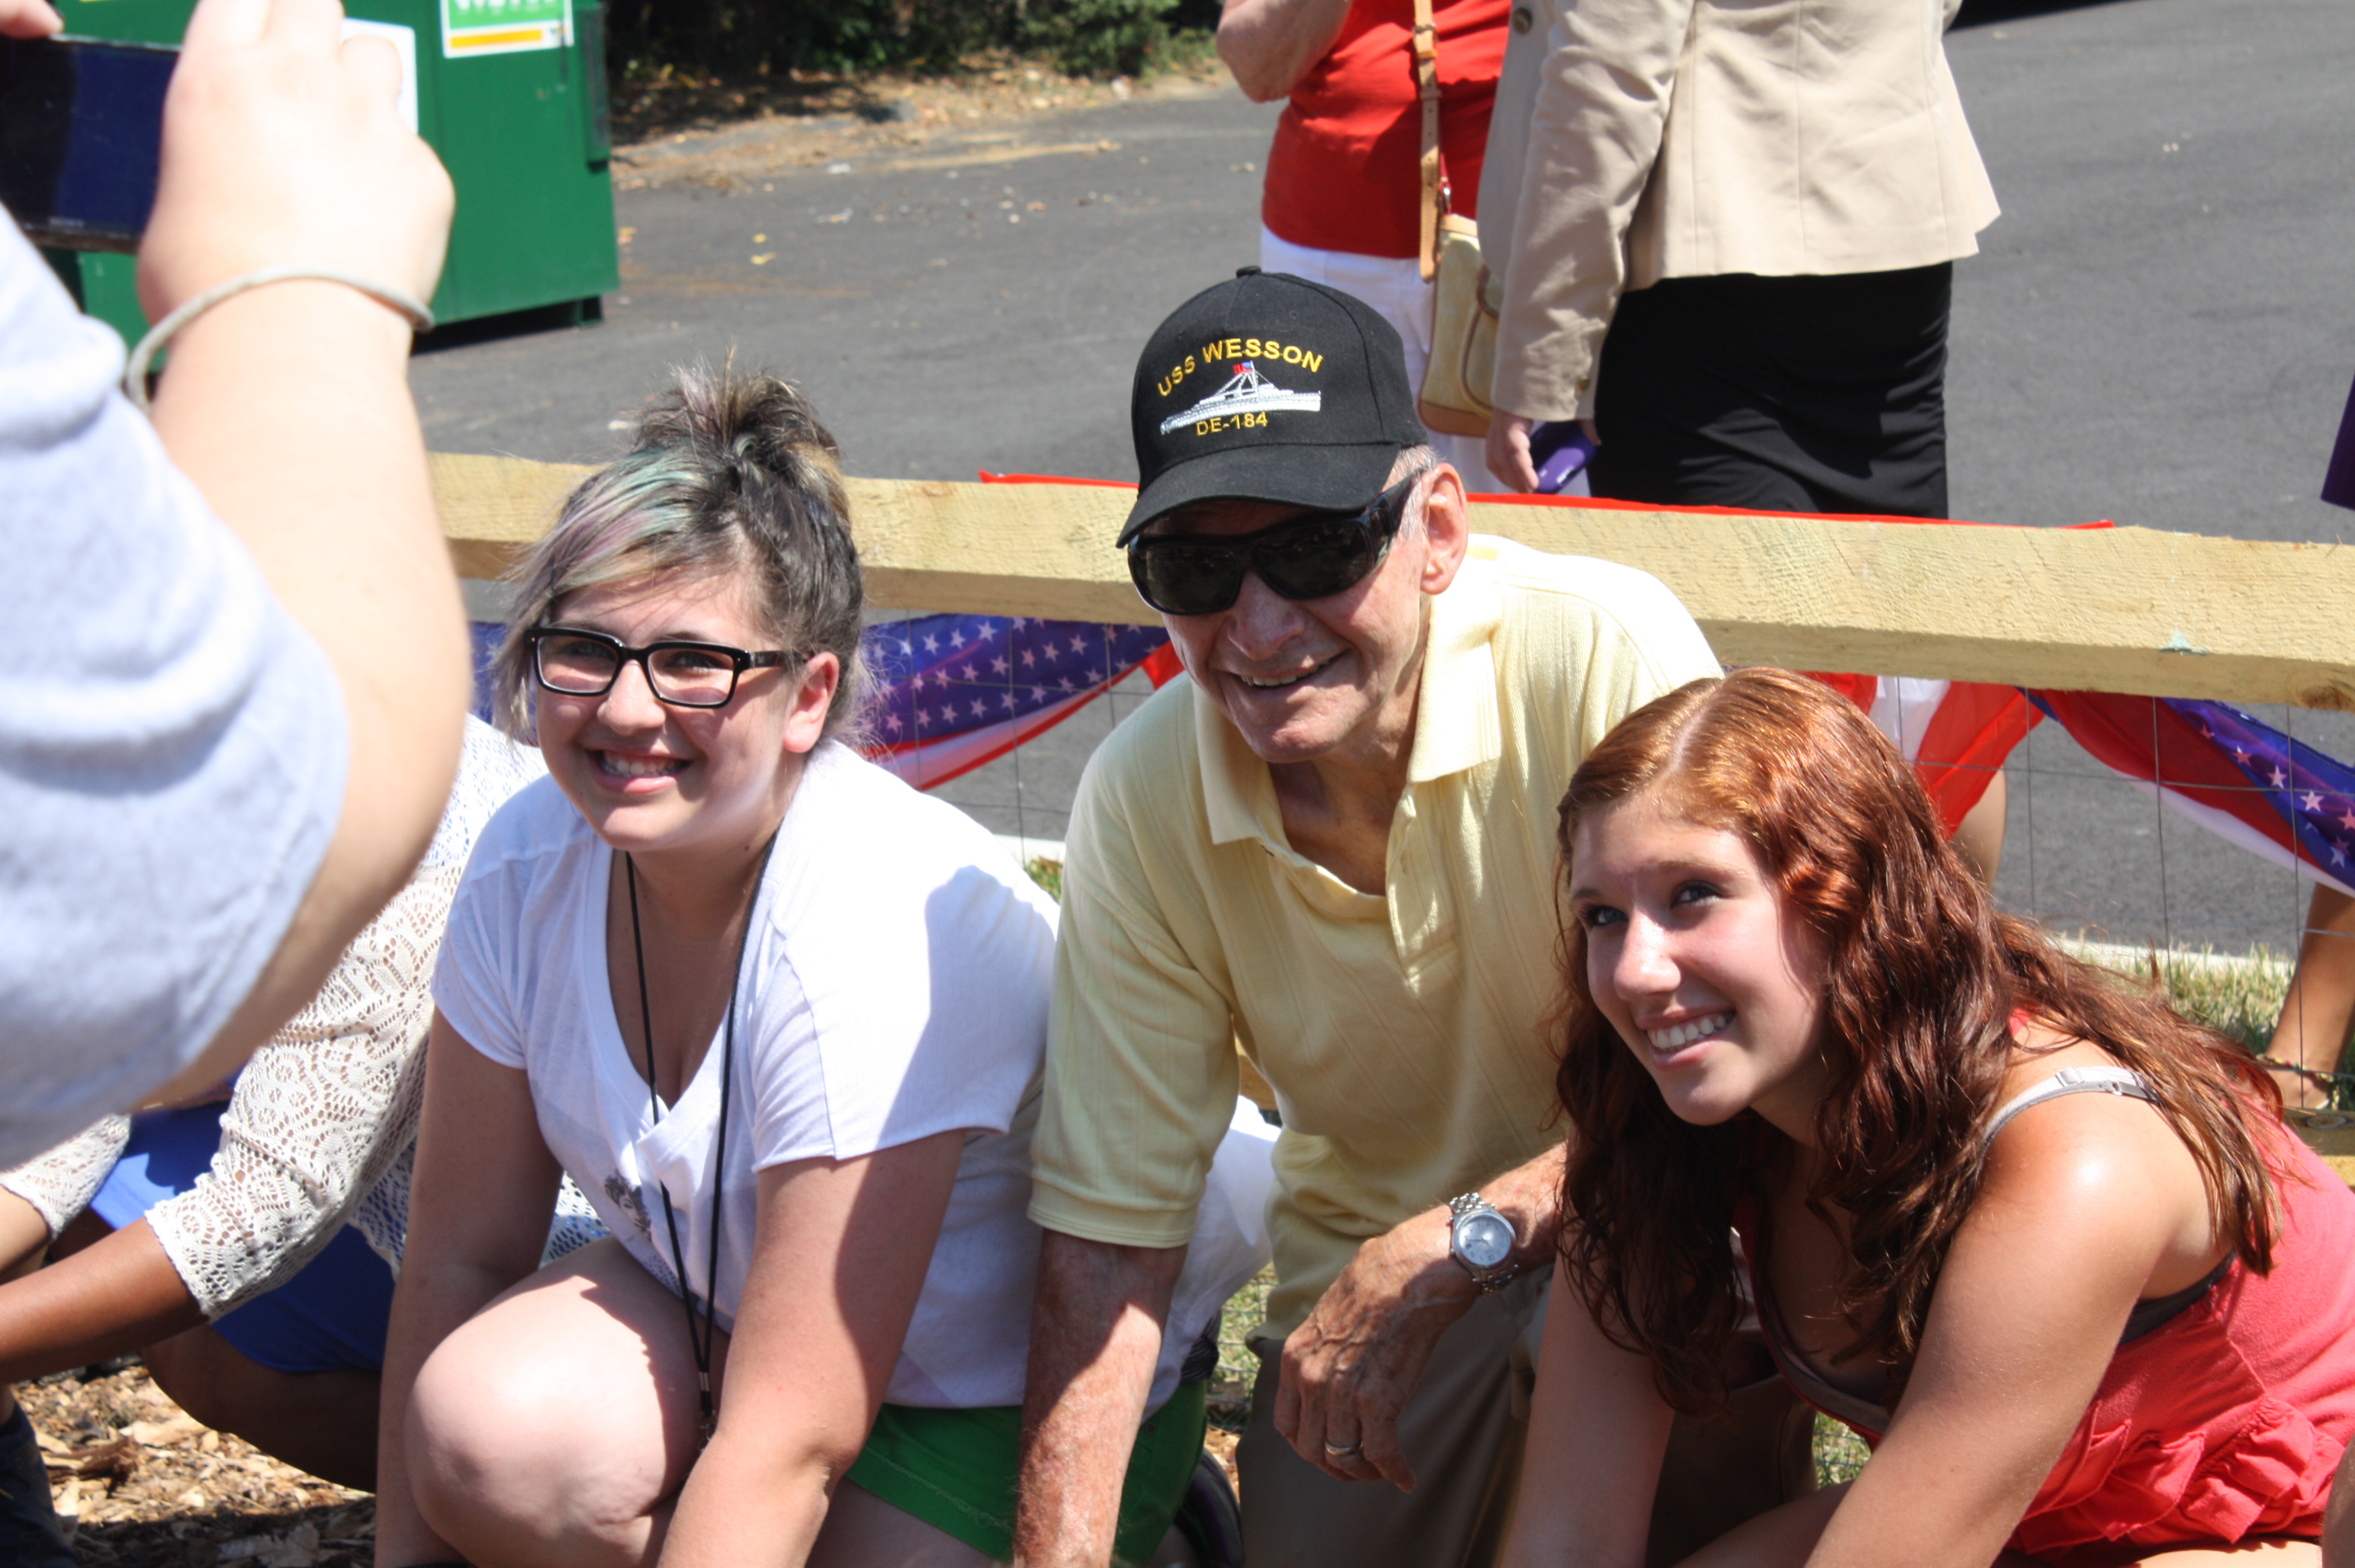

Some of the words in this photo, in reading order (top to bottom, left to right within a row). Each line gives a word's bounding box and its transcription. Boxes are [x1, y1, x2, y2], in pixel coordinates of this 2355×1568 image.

[1157, 355, 1196, 397] USS
[1202, 338, 1324, 373] WESSON
[1196, 412, 1269, 436] DE-184
